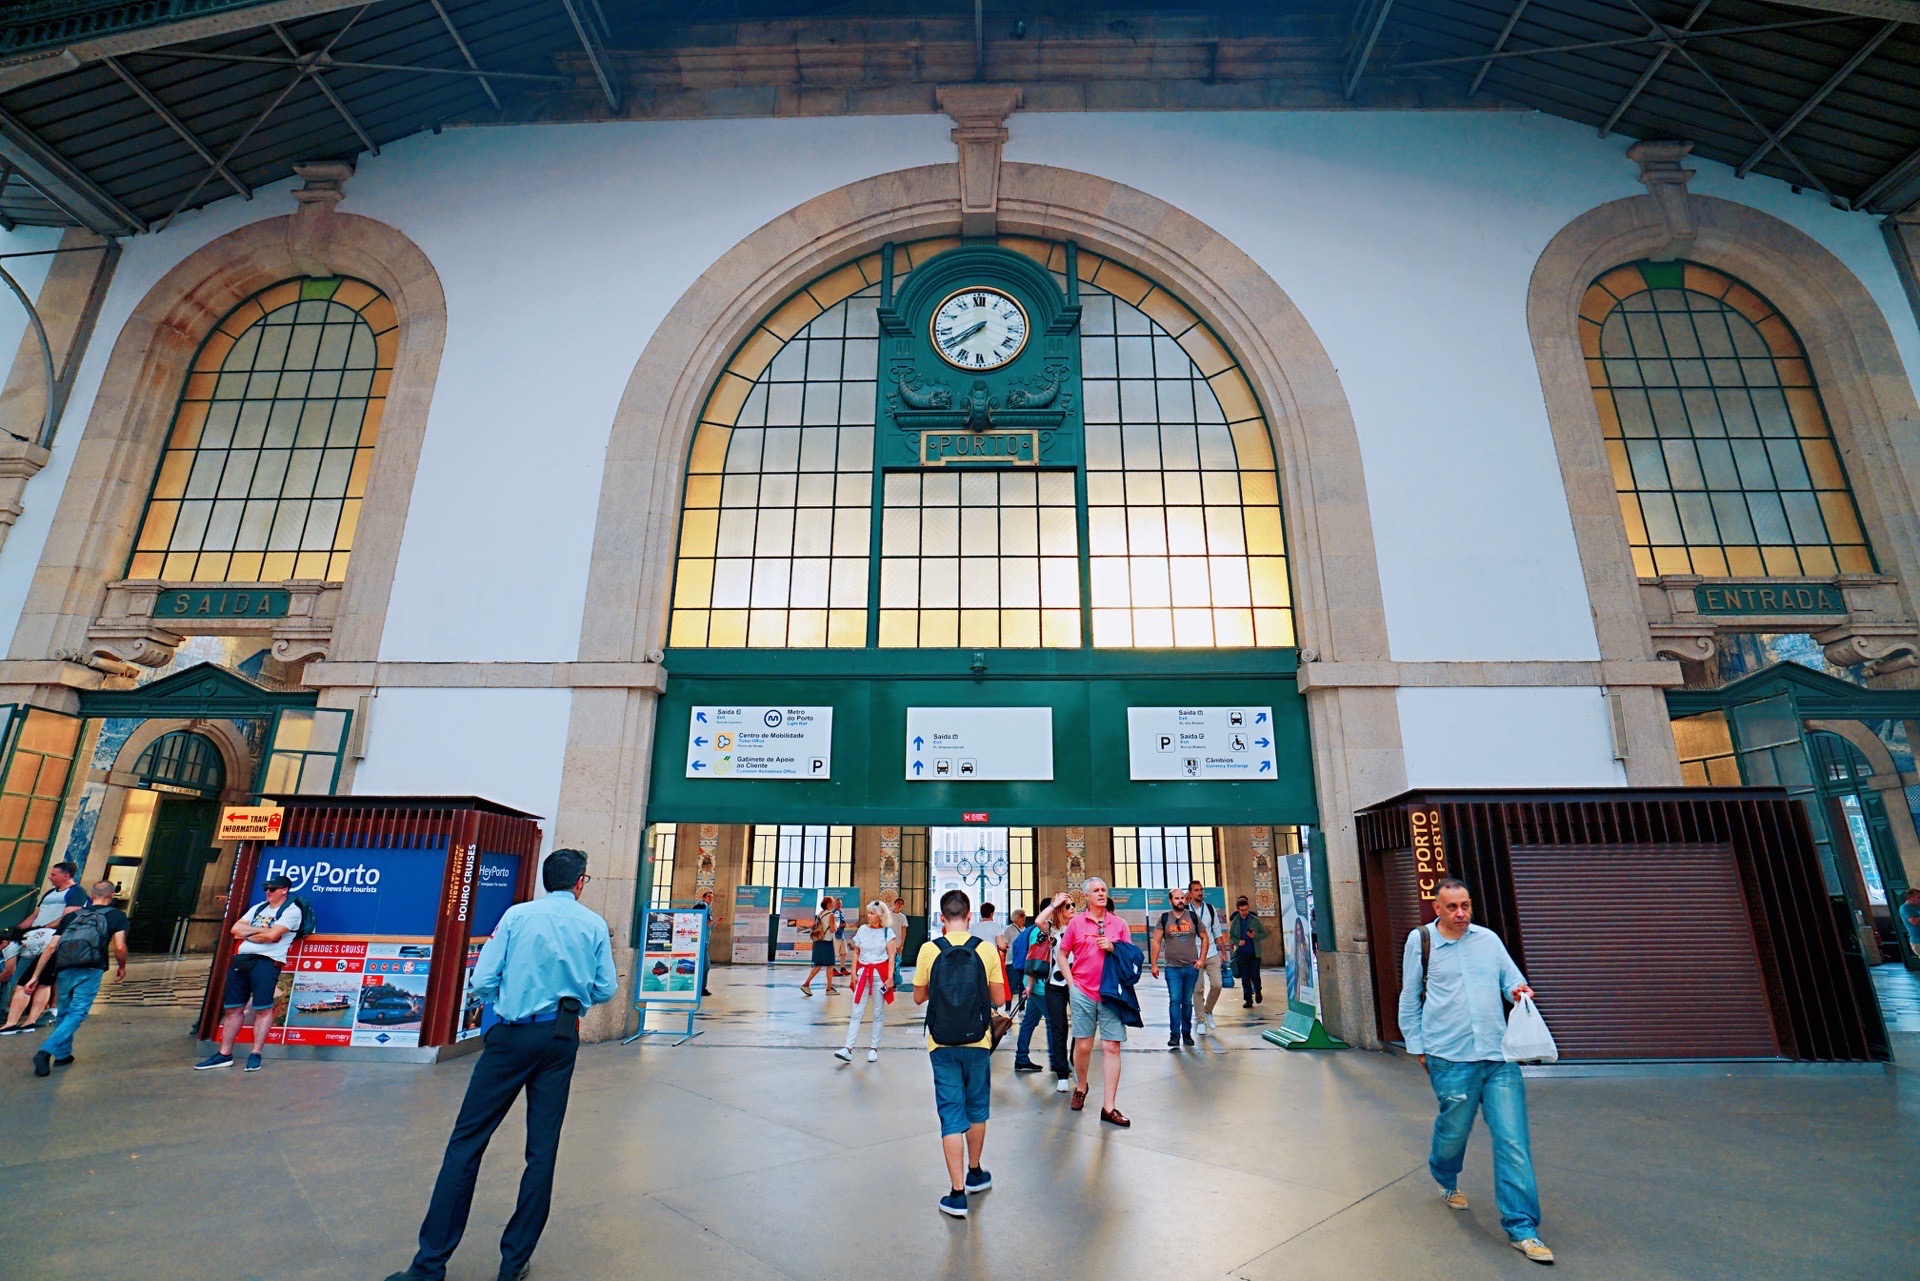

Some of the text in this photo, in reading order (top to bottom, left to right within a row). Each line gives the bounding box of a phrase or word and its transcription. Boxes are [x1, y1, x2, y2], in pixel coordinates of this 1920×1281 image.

[973, 297, 986, 307] XII
[941, 327, 953, 336] IX
[939, 436, 1019, 456] PORTO
[173, 594, 270, 614] SAIDA
[1706, 589, 1832, 610] ENTRADA
[1160, 737, 1171, 749] P
[812, 760, 823, 772] P
[1430, 810, 1446, 872] PORTO
[1412, 812, 1436, 900] FC PORTO
[266, 859, 380, 892] HeyPorto
[458, 844, 476, 921] DOURO CRUISES
[479, 865, 509, 881] HeyPorto
[452, 876, 460, 903] TICKET
[309, 944, 339, 953] BRIDGE'S
[341, 945, 365, 954] CRUISE
